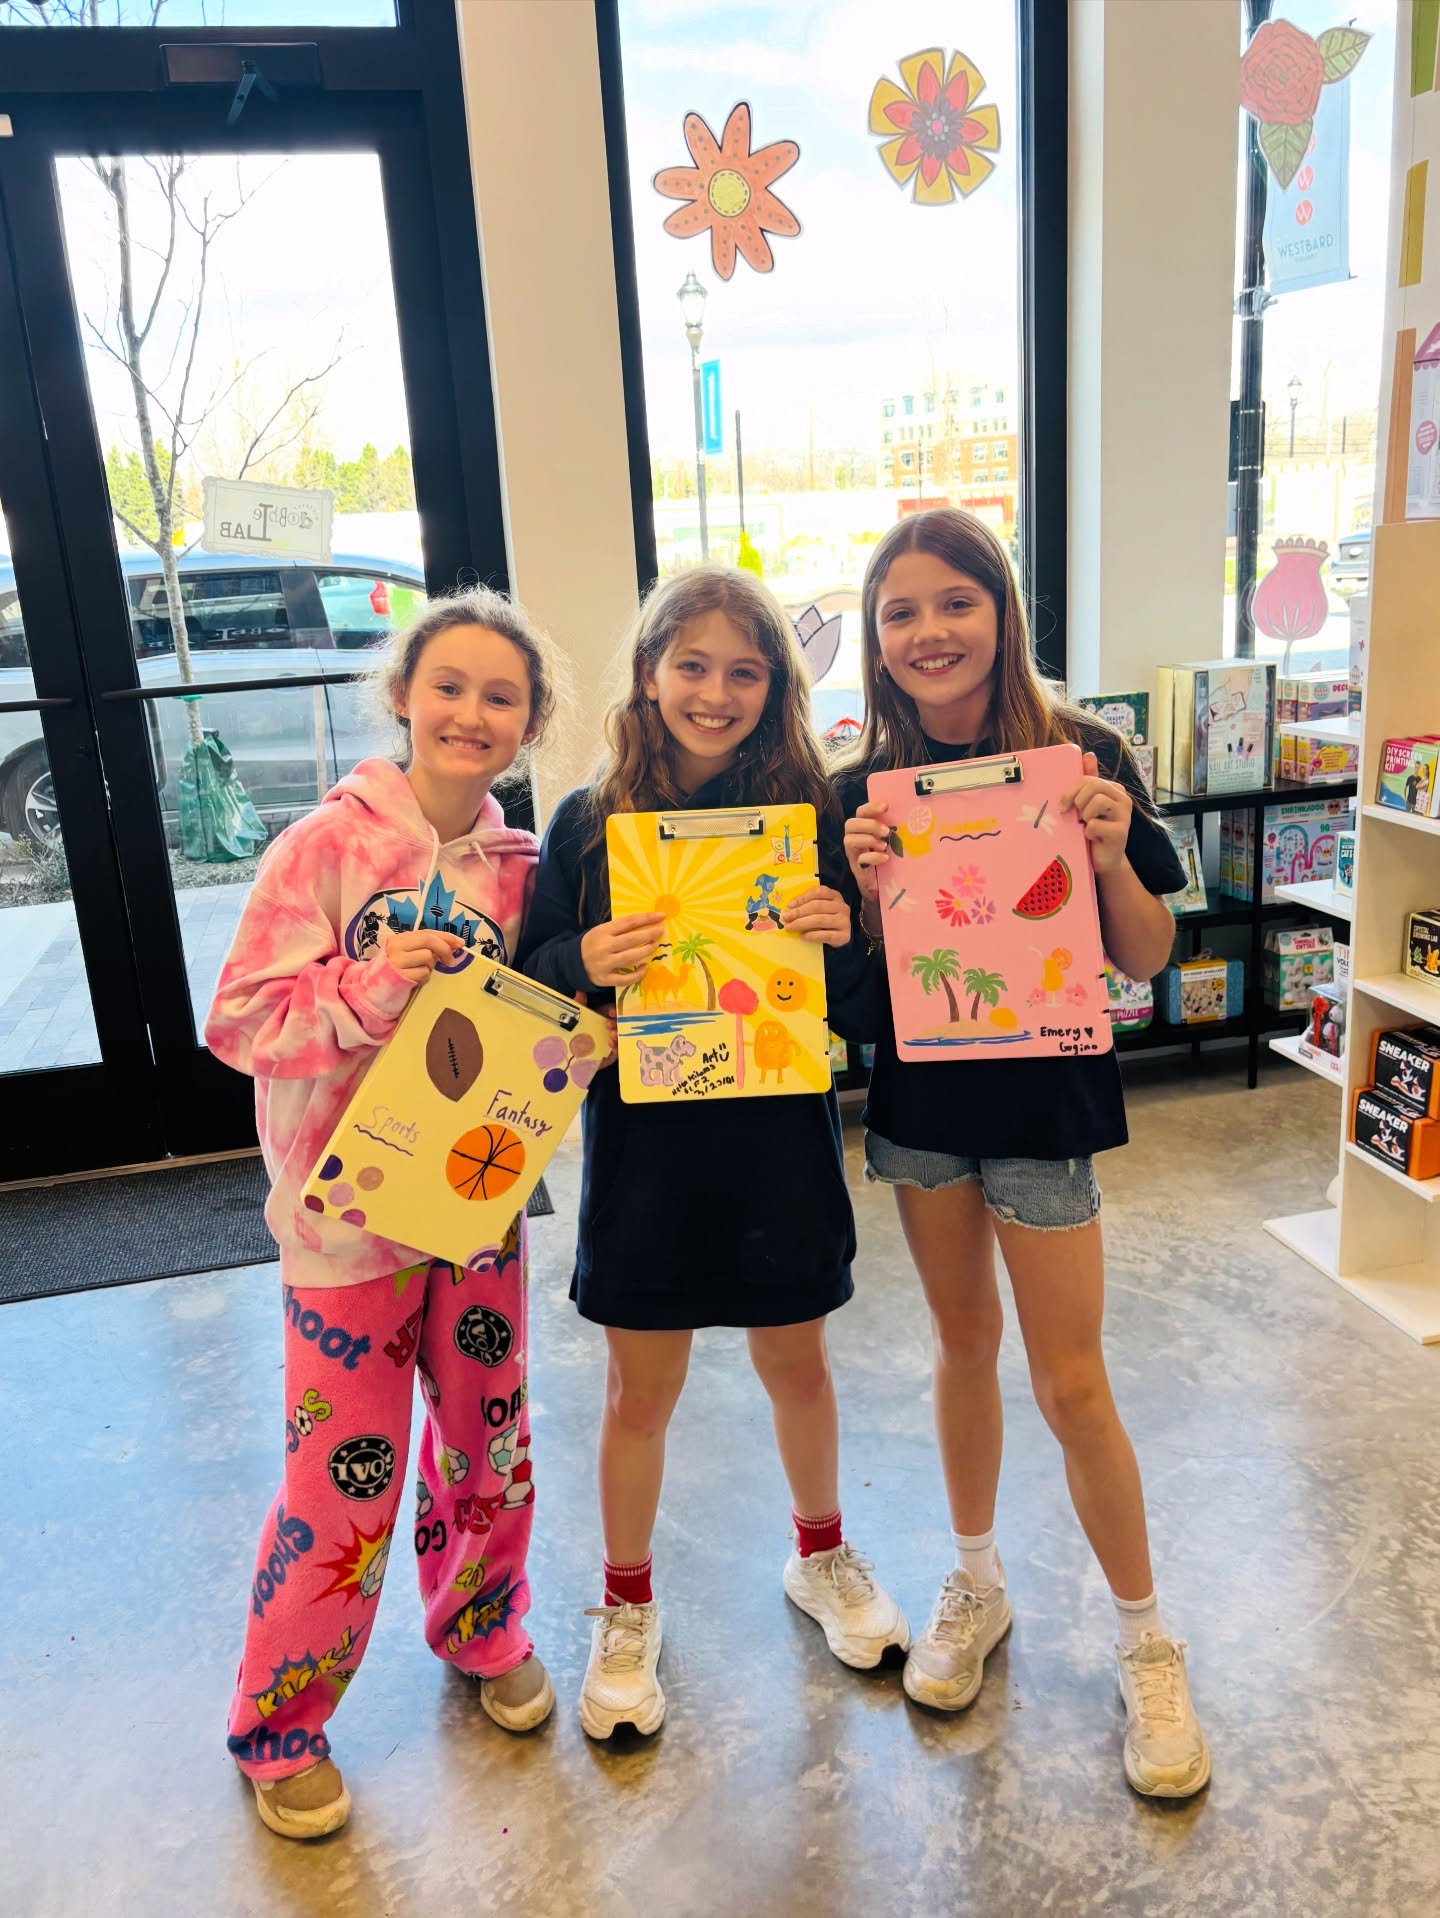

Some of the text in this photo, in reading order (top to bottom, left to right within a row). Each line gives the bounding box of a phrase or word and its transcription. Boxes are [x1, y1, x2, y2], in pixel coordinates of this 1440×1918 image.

[1278, 234, 1334, 258] WESTBARD
[1040, 1026, 1080, 1041] Emery
[702, 1048, 718, 1064] Art
[1379, 1040, 1430, 1073] SNEAKER
[361, 1106, 421, 1143] Sports
[487, 1089, 552, 1137] Fantasy
[1358, 1098, 1409, 1134] SNEAKER
[285, 1287, 371, 1371] hoot
